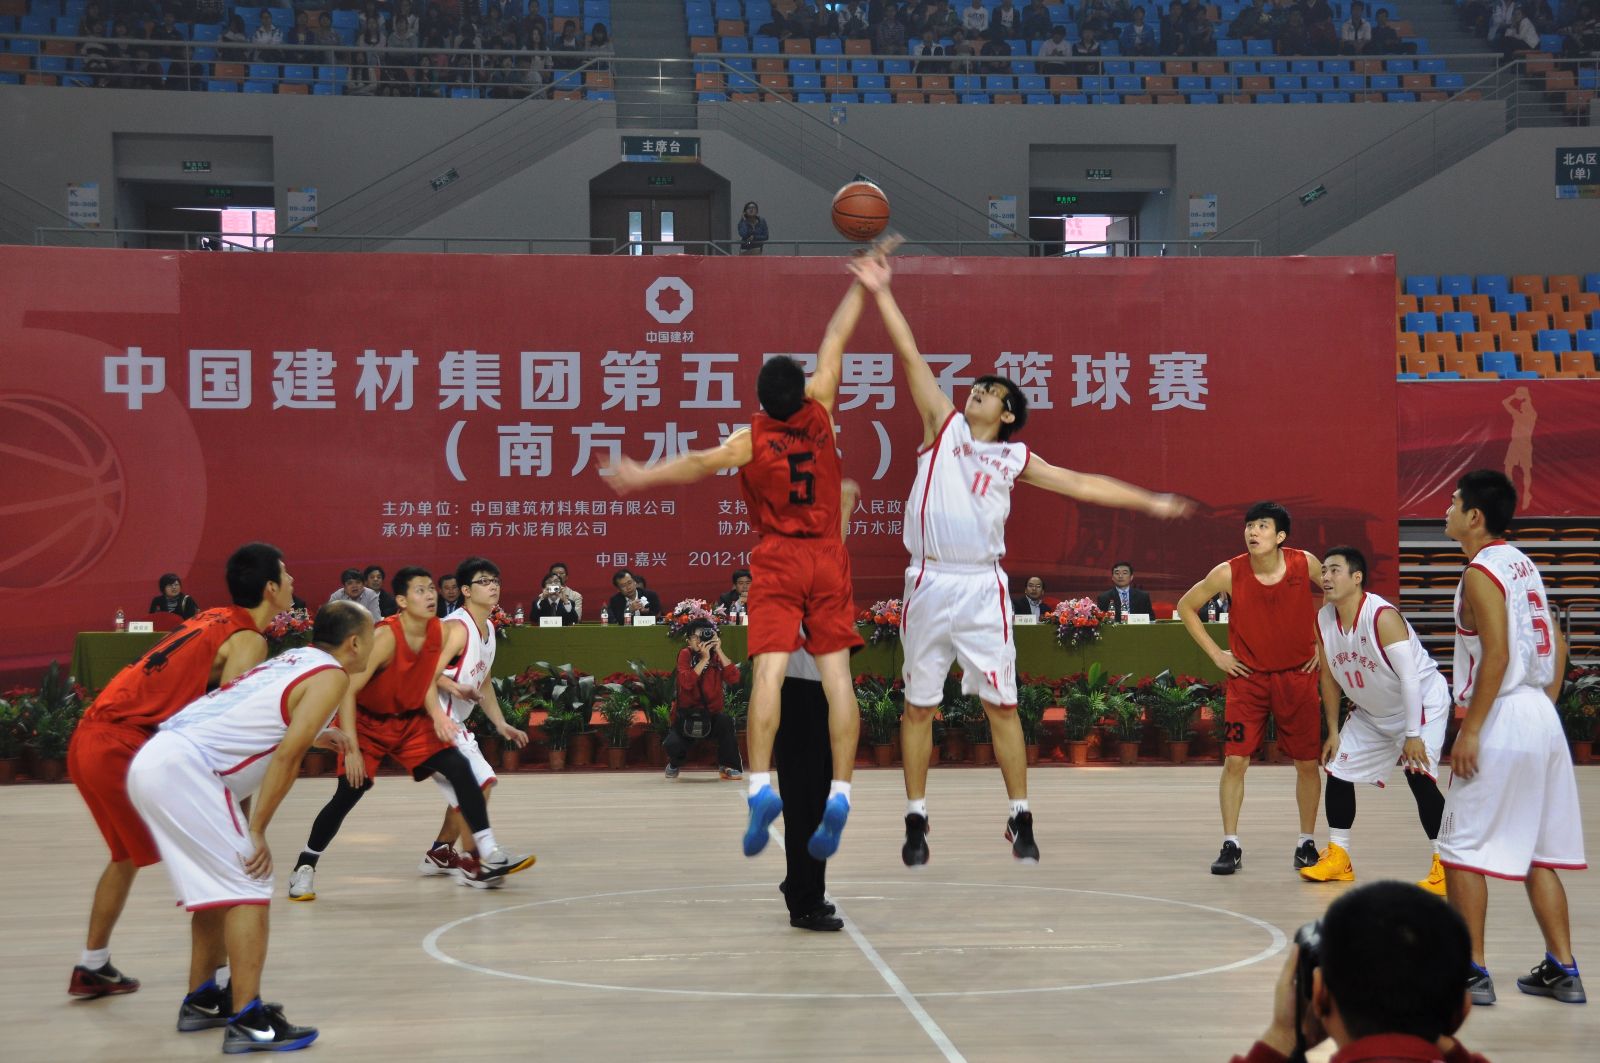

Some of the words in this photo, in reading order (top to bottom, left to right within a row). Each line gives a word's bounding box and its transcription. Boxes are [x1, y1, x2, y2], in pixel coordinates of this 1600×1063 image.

[642, 140, 680, 152] 主席台
[1562, 153, 1597, 166] 北A区
[646, 331, 694, 343] 中国建材
[788, 451, 816, 506] 5
[970, 470, 993, 497] 11
[596, 552, 667, 567] 中国·嘉兴
[1344, 670, 1365, 689] 10
[1225, 721, 1246, 743] 23
